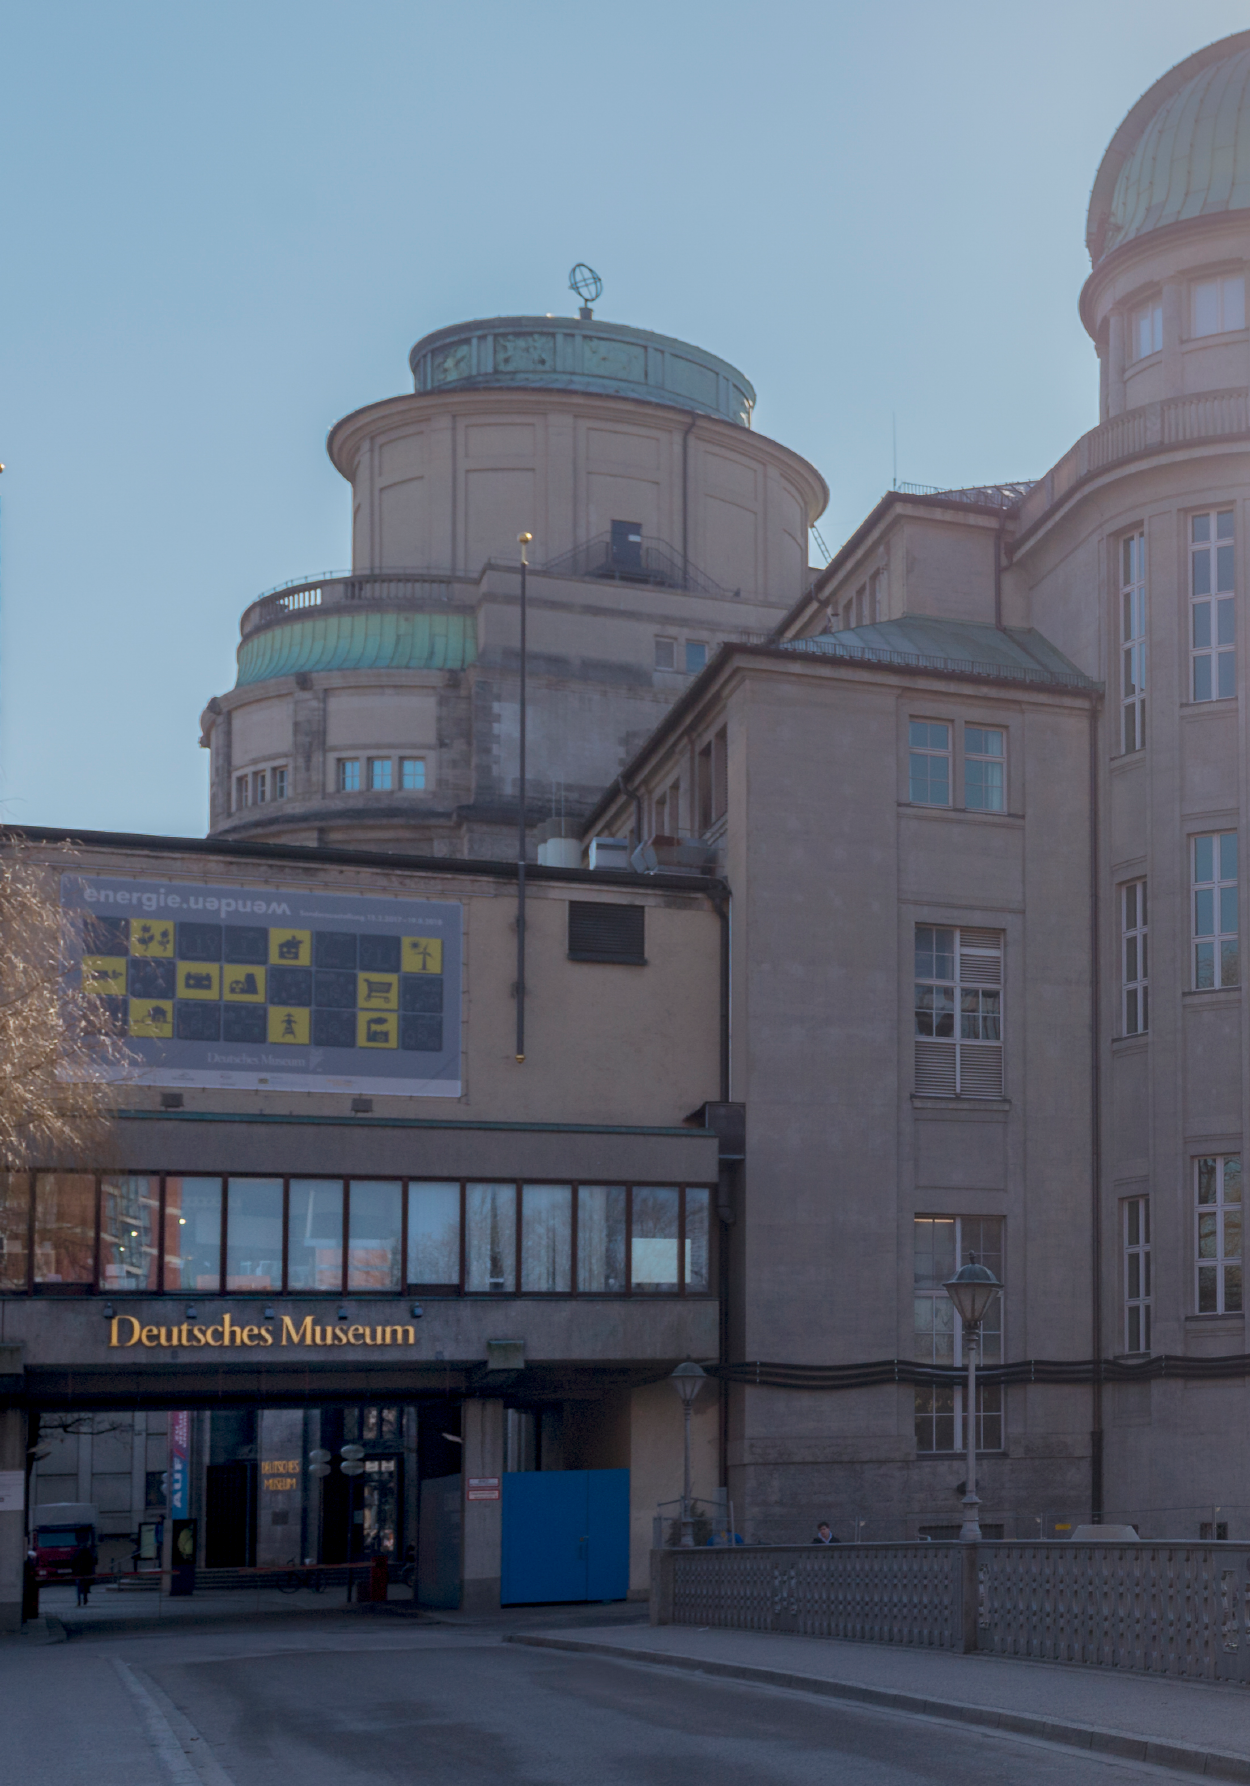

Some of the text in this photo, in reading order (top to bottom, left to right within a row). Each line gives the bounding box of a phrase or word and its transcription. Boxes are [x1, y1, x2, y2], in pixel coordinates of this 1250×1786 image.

[207, 1052, 306, 1067] Deutsches Museum
[109, 1313, 415, 1348] Deutsches Museum
[261, 1460, 300, 1474] DEUTSCHES
[173, 1457, 182, 1508] AUF
[264, 1477, 297, 1490] MUSEUM
